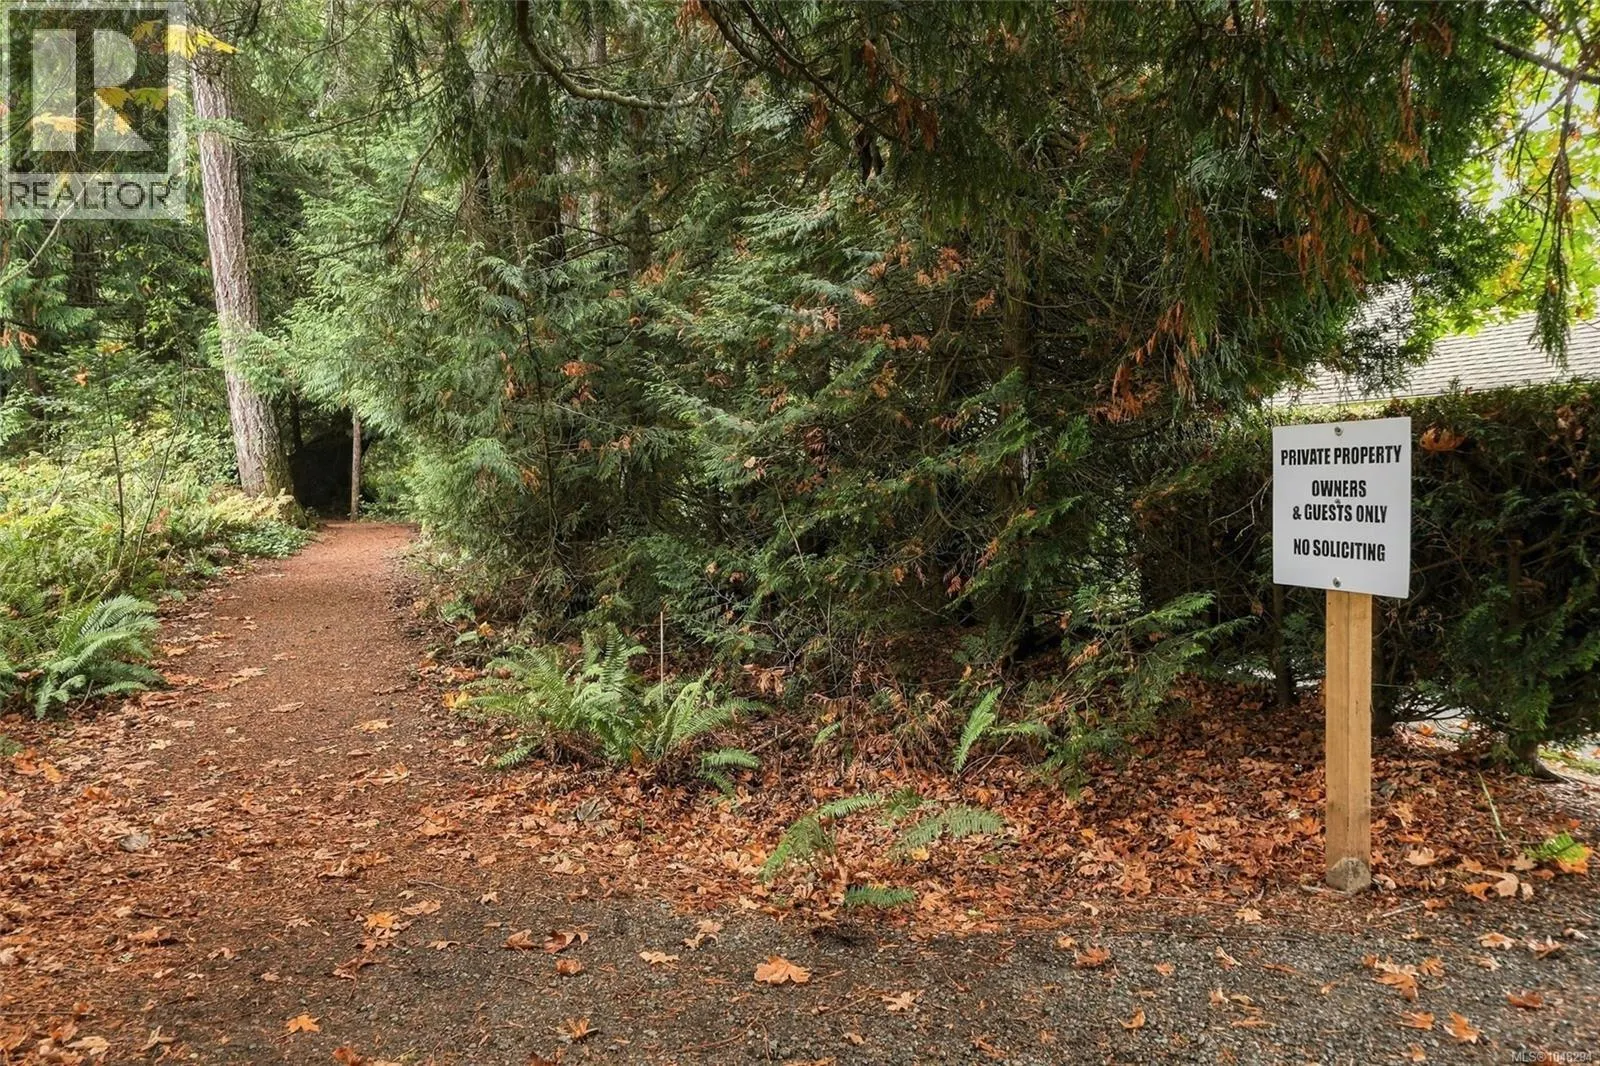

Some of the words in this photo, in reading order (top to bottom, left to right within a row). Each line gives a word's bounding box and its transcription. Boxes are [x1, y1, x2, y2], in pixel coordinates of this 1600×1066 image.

[1281, 448, 1330, 465] PRIVATE
[1334, 445, 1402, 464] PROPERTY
[1312, 480, 1367, 497] OWNERS
[1293, 506, 1302, 520] &
[1304, 504, 1352, 521] GUESTS
[1356, 505, 1388, 523] ONLY
[1294, 539, 1310, 556] NO
[1313, 540, 1386, 562] SOLICITING
